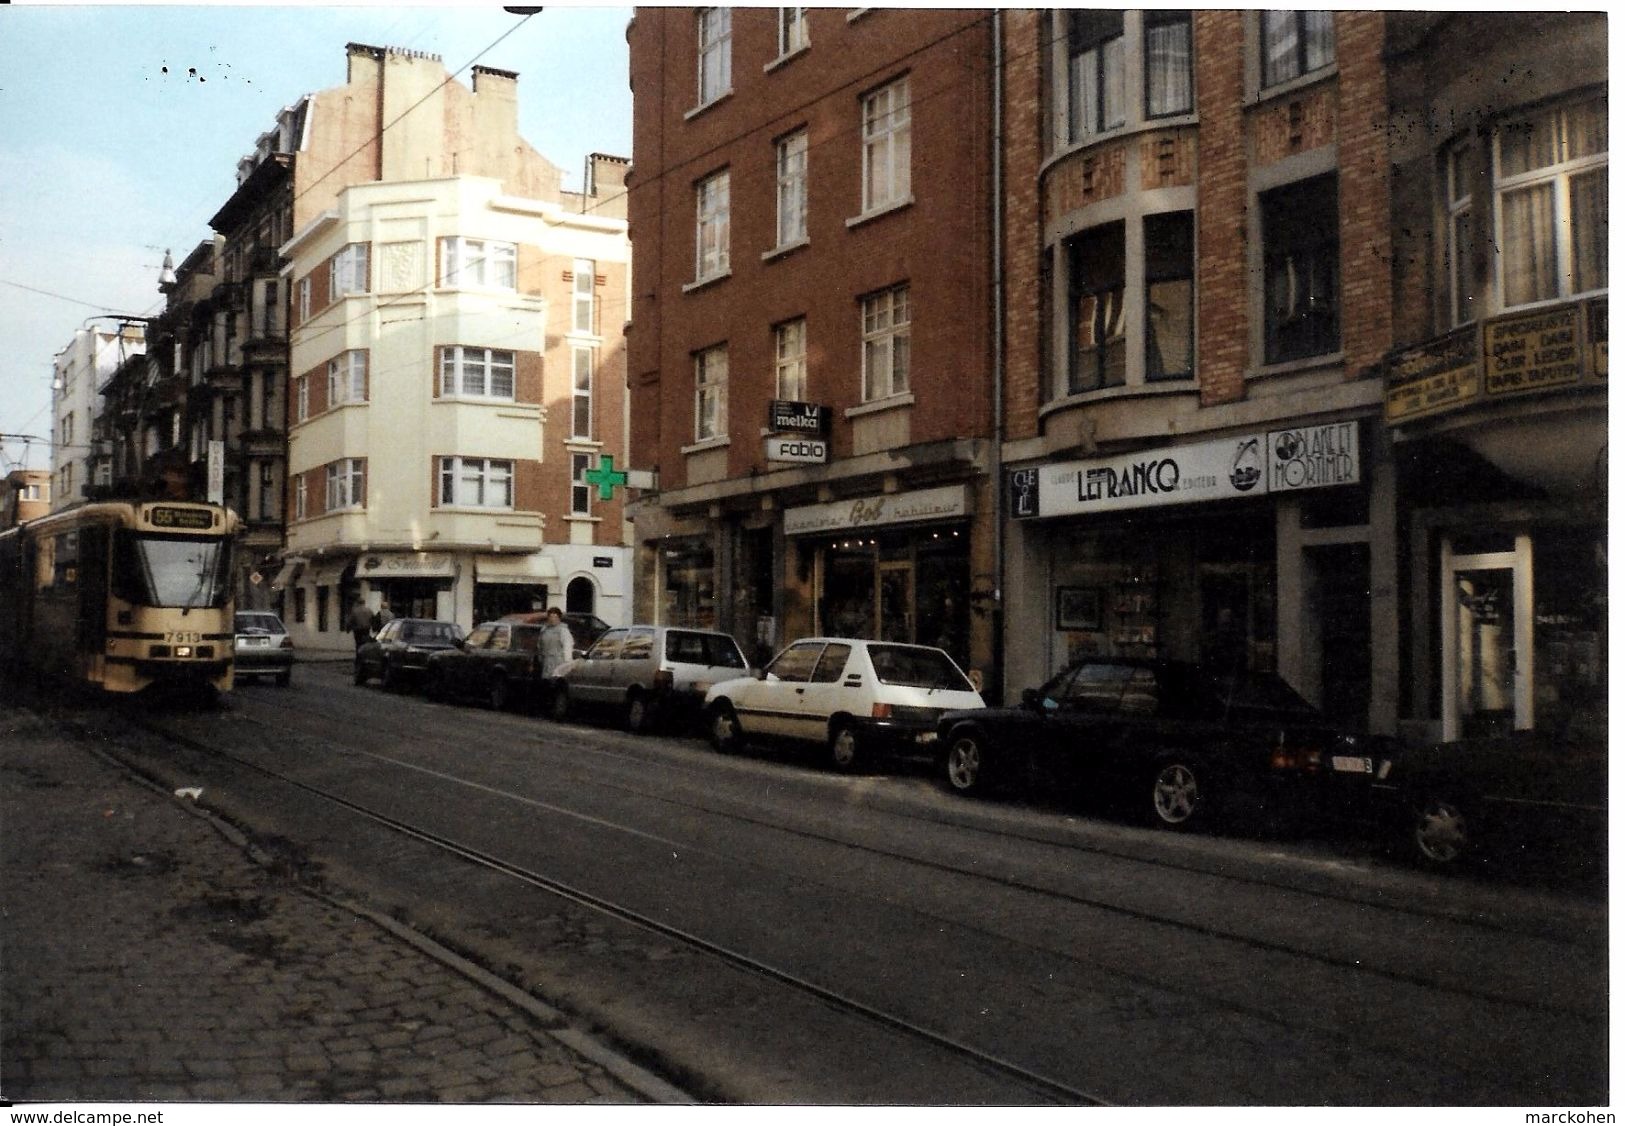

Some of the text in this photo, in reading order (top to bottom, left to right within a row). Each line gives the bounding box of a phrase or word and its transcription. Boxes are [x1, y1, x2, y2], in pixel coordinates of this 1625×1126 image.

[776, 414, 817, 428] melka
[1296, 424, 1352, 457] BLAKE ET
[1078, 458, 1180, 502] LEFRANCQ
[1274, 454, 1353, 488] MORTIMER
[849, 498, 886, 526] Bob
[165, 632, 200, 644] 7913
